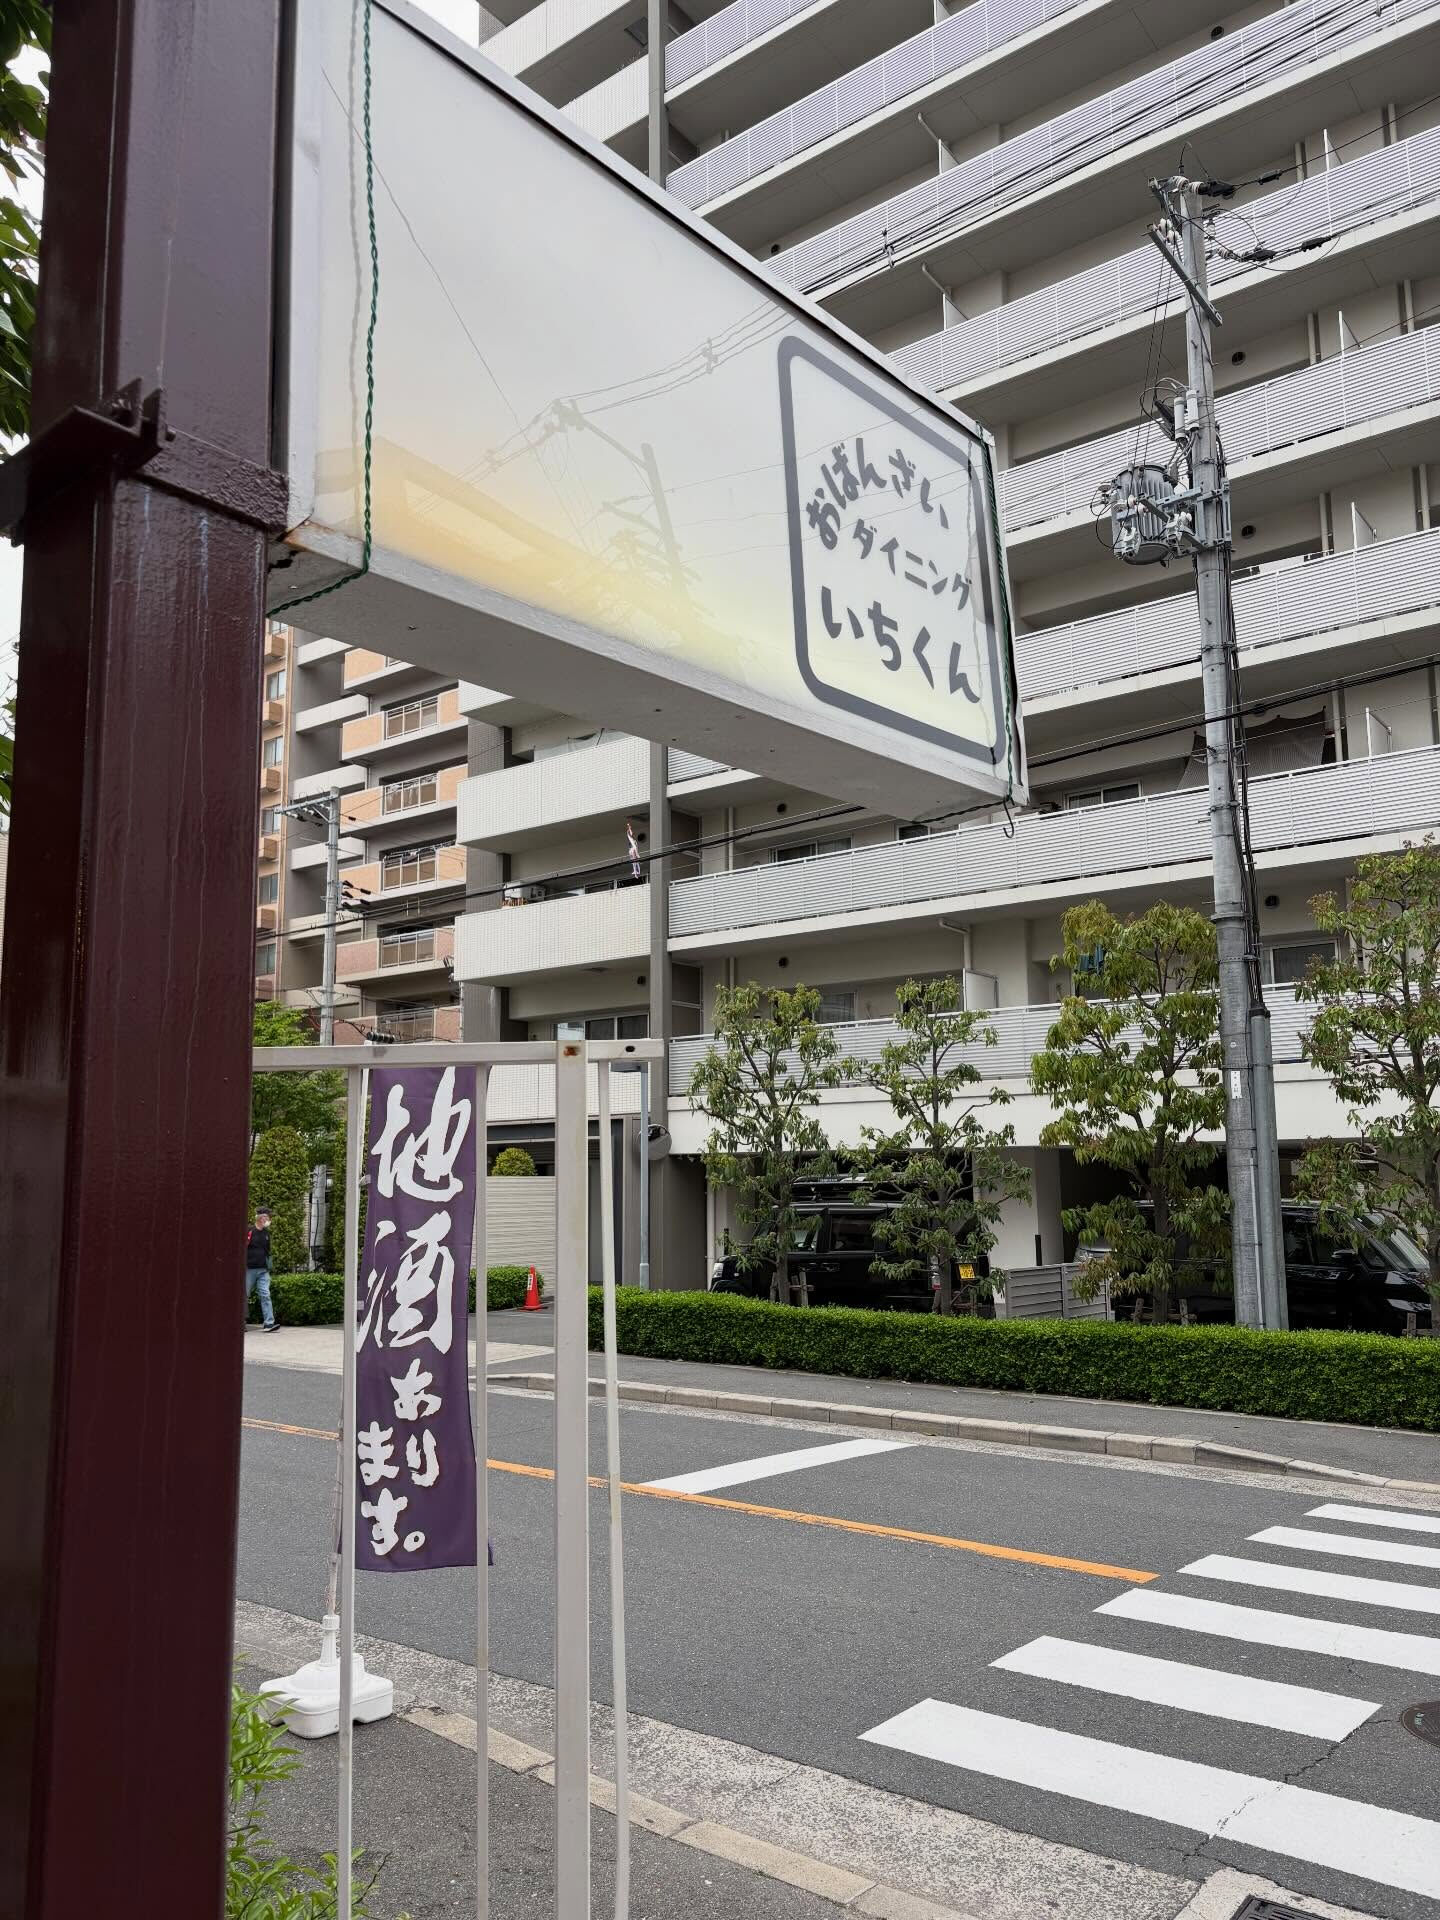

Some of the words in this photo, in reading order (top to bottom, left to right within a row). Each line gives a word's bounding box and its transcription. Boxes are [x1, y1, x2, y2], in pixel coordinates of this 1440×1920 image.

[806, 437, 949, 550] おばんざい
[853, 519, 973, 611] ダイニング
[821, 585, 981, 704] いちくん
